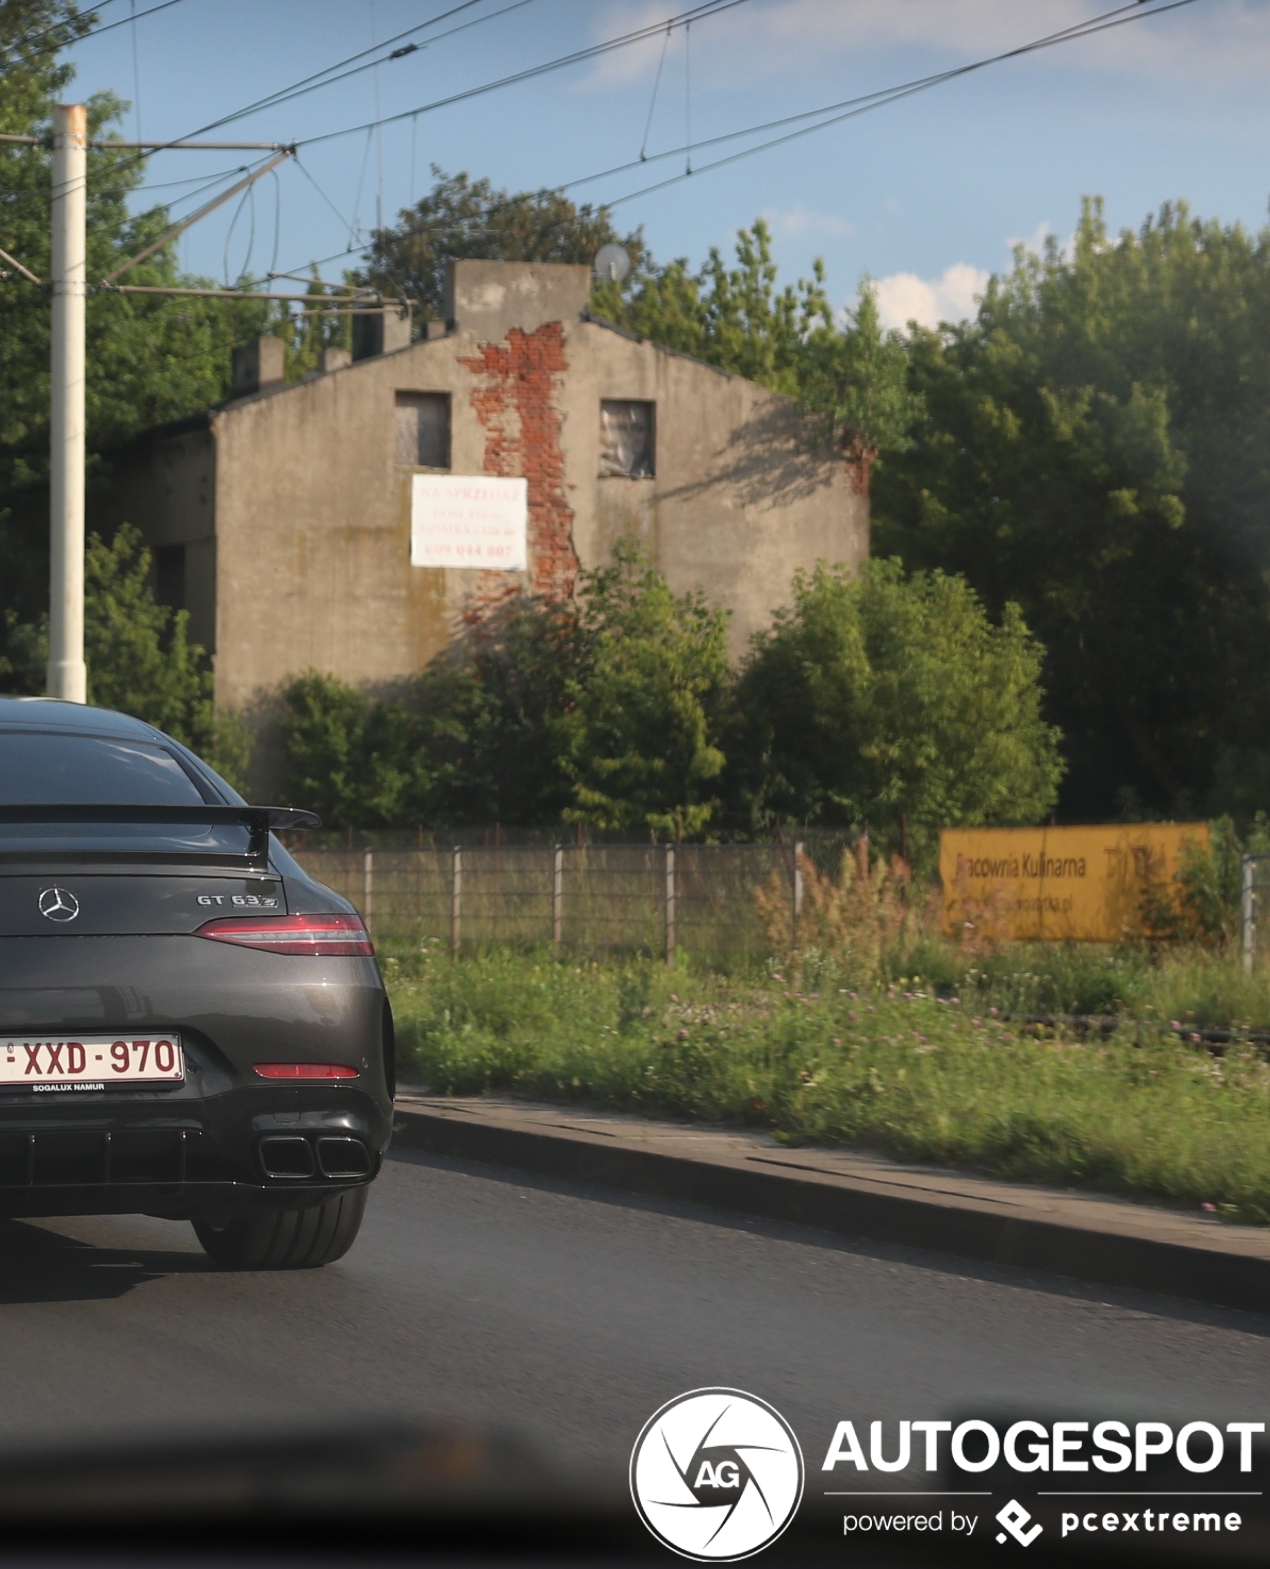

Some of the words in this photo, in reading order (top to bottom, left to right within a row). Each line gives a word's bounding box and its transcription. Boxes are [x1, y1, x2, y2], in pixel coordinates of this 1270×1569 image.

[197, 895, 225, 905] GT
[231, 894, 260, 905] 63
[32, 1084, 73, 1092] SOGALUX
[74, 1083, 105, 1091] NAMUR
